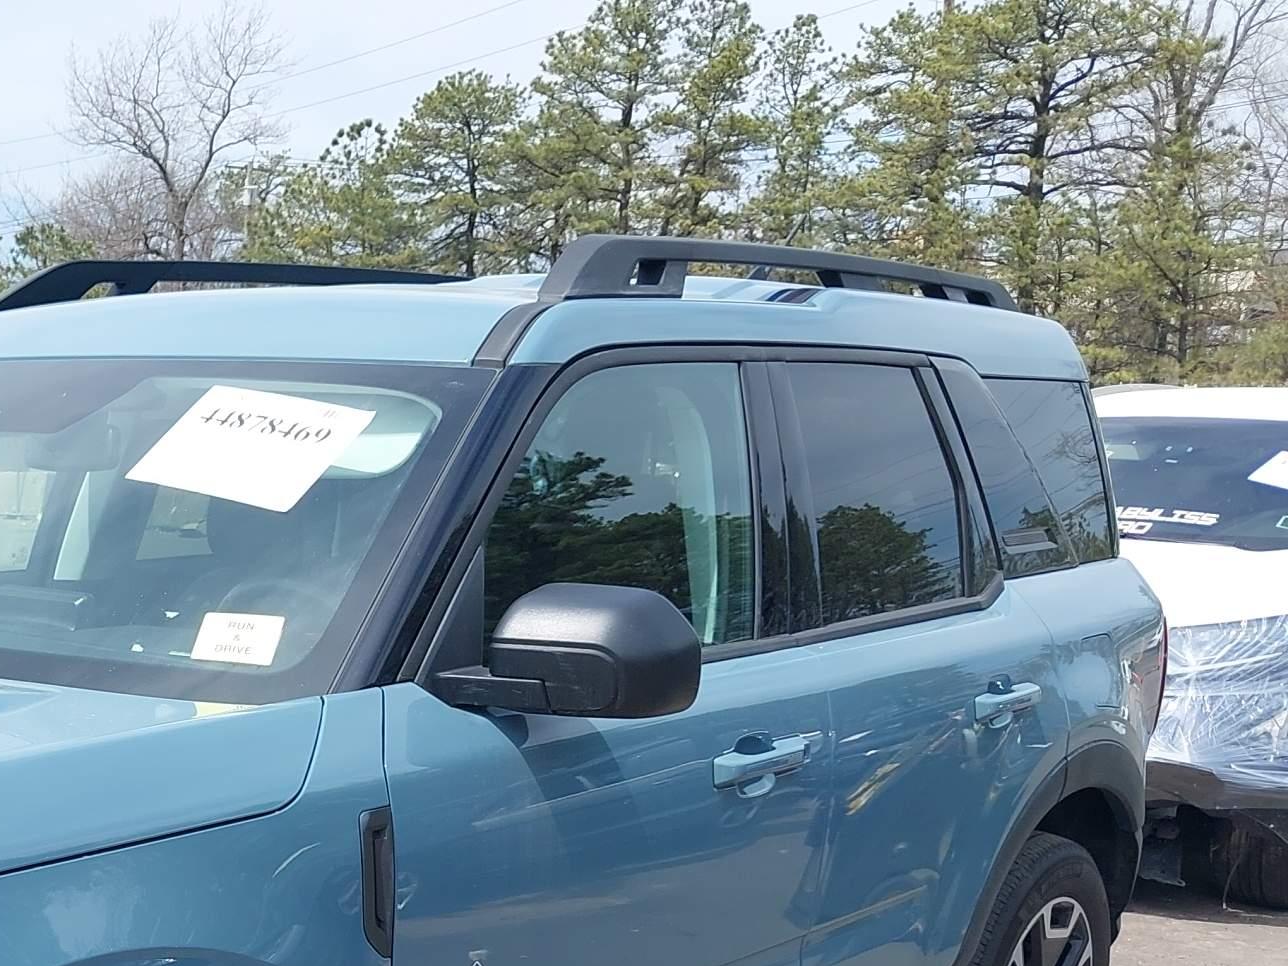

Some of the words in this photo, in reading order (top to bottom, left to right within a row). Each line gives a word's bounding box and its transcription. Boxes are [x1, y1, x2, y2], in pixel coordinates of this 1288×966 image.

[199, 408, 332, 443] 44878469
[227, 621, 255, 631] RUN
[214, 644, 253, 655] DRIVE
